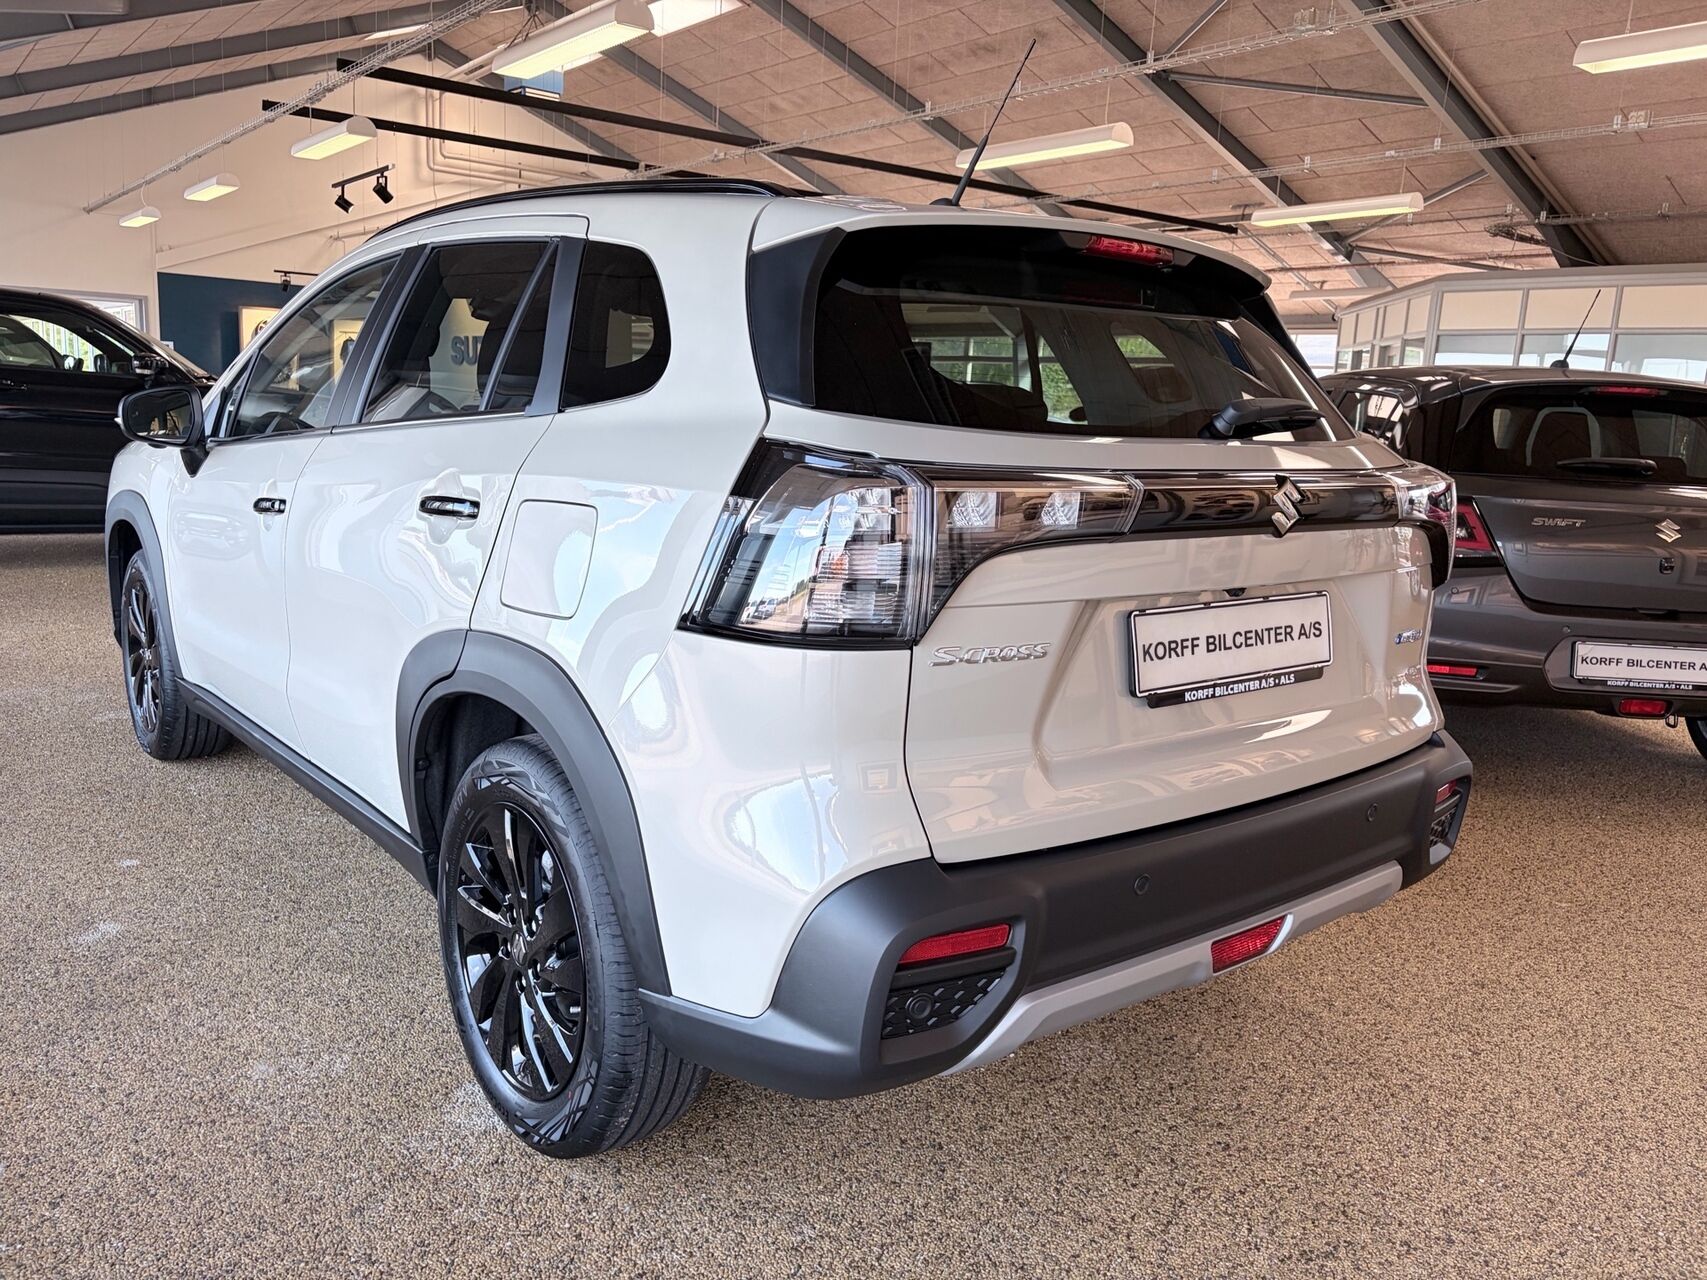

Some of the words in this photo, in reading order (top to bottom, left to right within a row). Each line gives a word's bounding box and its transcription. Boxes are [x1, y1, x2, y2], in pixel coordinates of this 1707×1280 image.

[451, 335, 482, 366] SU
[1531, 517, 1586, 527] SWIFT
[1142, 636, 1200, 662] KORFF
[1206, 625, 1294, 653] BILCENTER
[1298, 621, 1323, 640] A/S
[1581, 656, 1623, 667] KORFF
[1627, 658, 1696, 671] BILCENTER
[1184, 688, 1214, 702] KORFF
[1214, 681, 1260, 697] BILCENTER
[1260, 677, 1275, 688] A/S
[1279, 674, 1295, 685] ALS
[1629, 681, 1664, 689] BILCENTER
